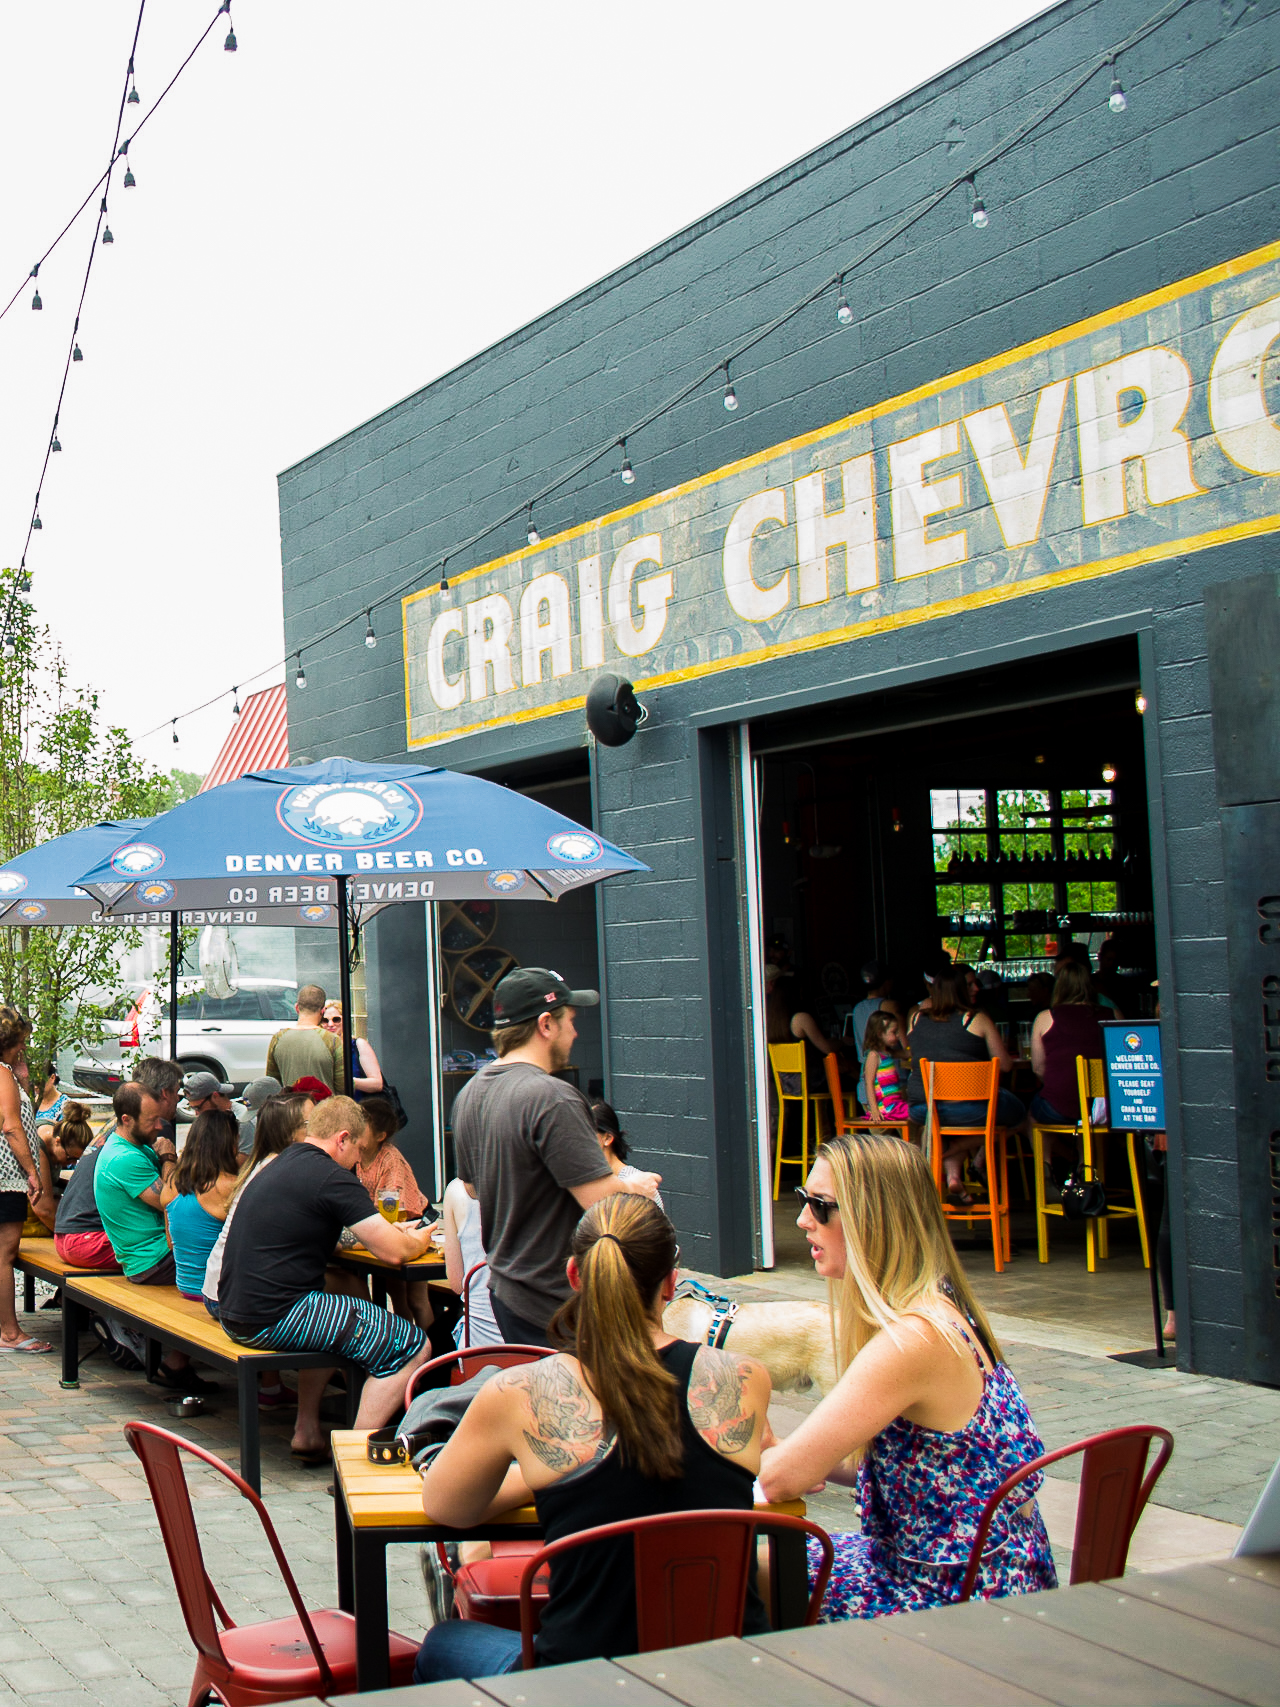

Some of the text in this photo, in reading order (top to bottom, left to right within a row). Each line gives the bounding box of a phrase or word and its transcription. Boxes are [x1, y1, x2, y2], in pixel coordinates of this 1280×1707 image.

[426, 532, 673, 711] CRAIG
[225, 848, 488, 872] DENVER BEER CO.
[1116, 1054, 1154, 1062] WELCOME TO
[1110, 1062, 1133, 1070] DENVER
[1123, 1088, 1151, 1096] YOURSELF
[1121, 1105, 1135, 1113] GRAB
[1141, 1105, 1156, 1113] BEER
[1132, 1114, 1143, 1122] THE
[1143, 1114, 1156, 1122] BAR
